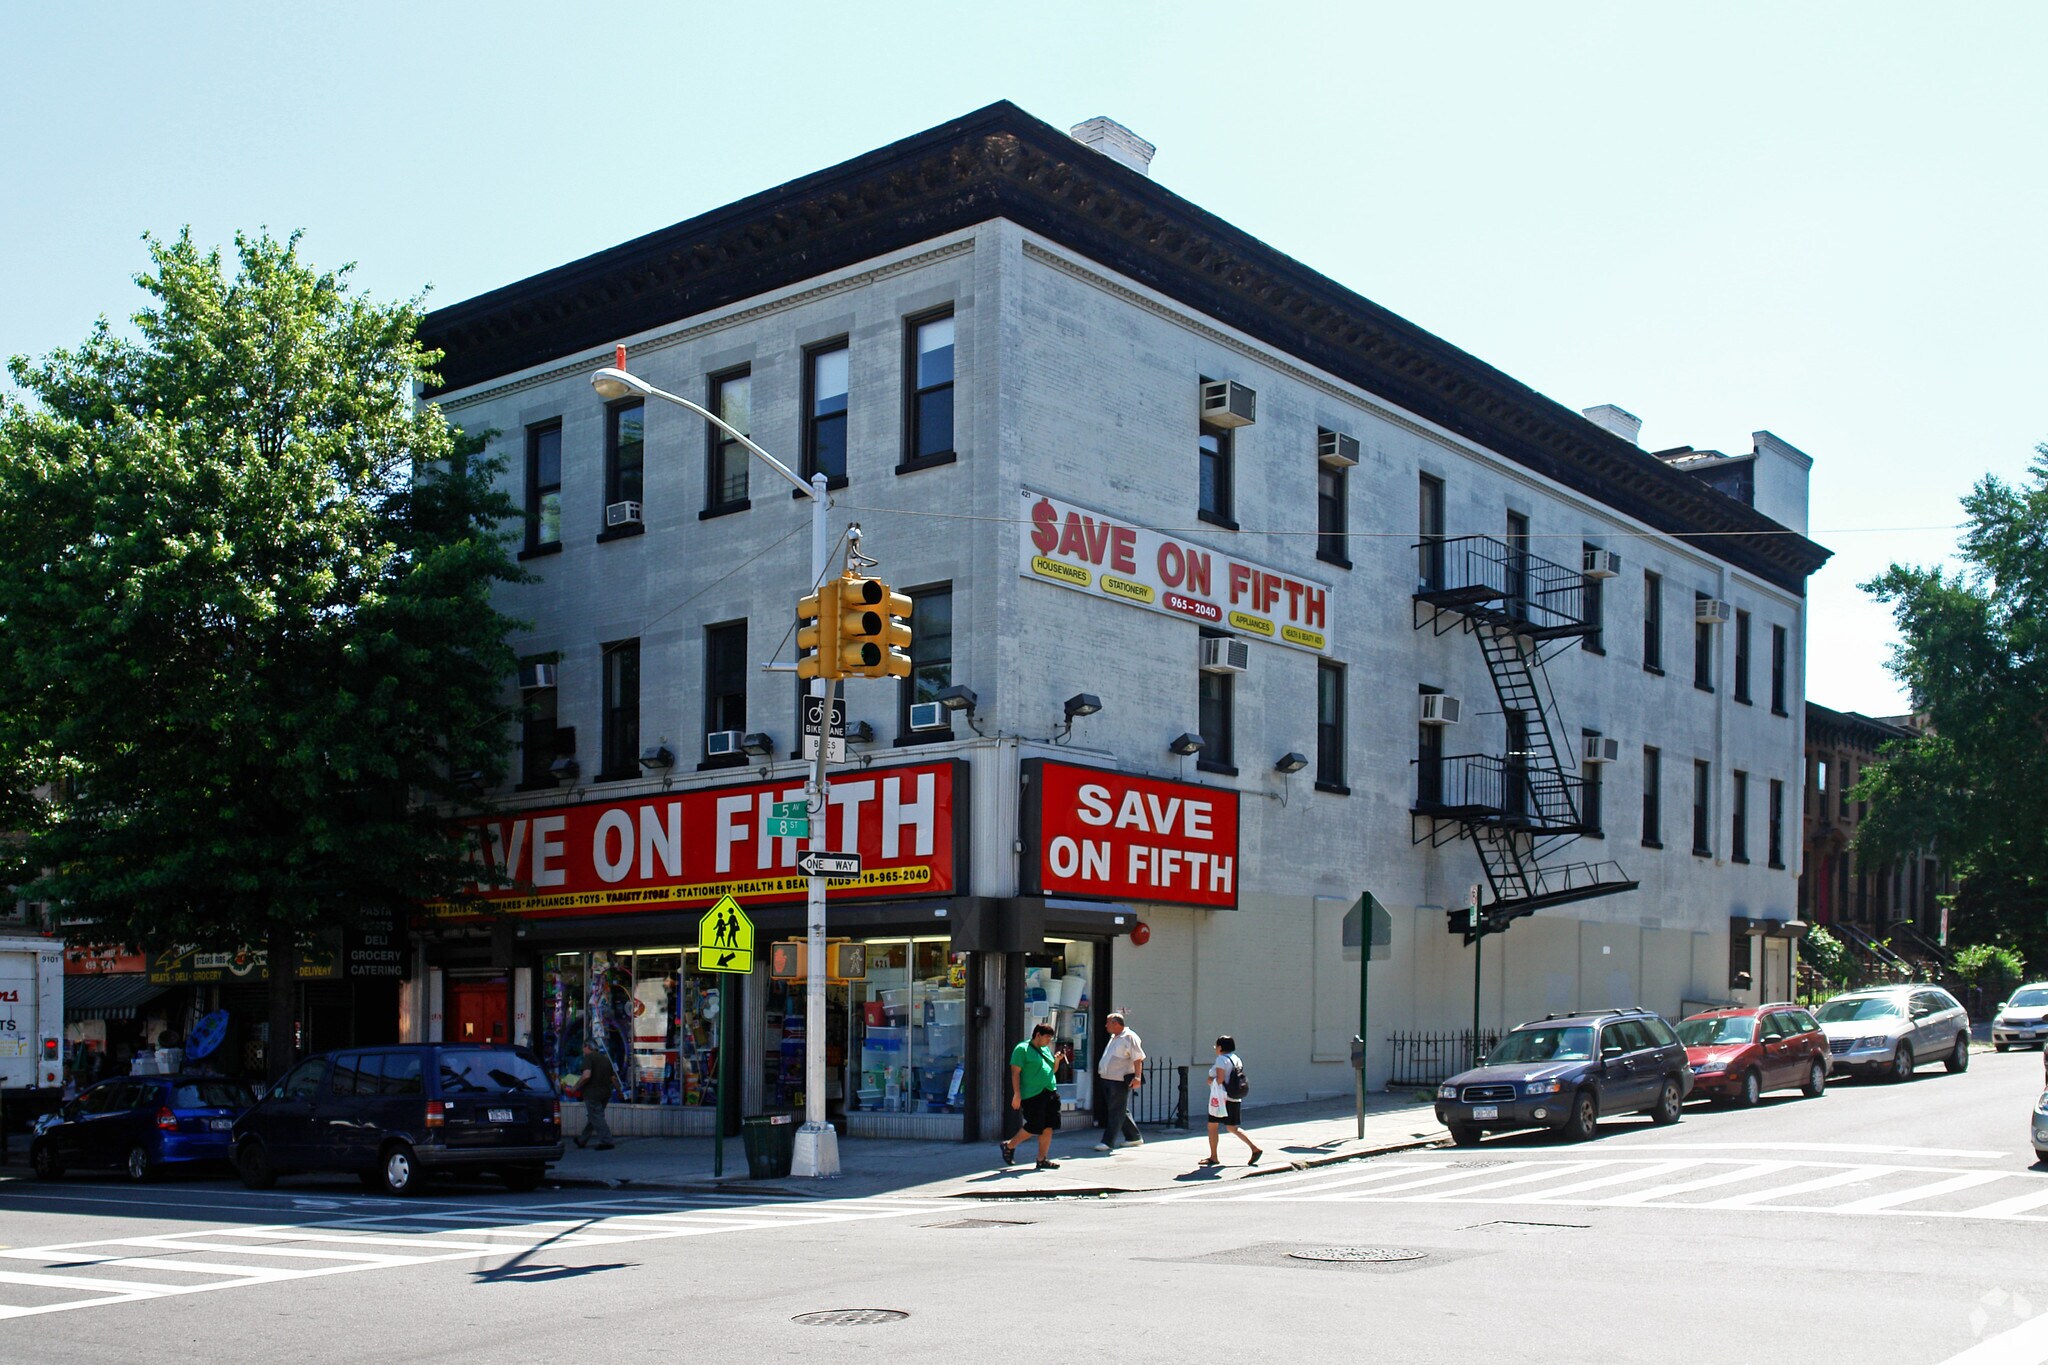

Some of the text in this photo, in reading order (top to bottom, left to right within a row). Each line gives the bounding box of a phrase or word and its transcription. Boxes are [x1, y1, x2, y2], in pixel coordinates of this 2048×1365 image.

[1021, 490, 1031, 499] 421
[1031, 497, 1325, 629] $AVE ON FIFTH
[1037, 559, 1087, 582] HOUSEWARES
[1108, 578, 1149, 597] STATIONERY
[1235, 614, 1271, 632] APPLIANCES
[805, 724, 844, 736] BIKE ANE
[814, 740, 836, 749] BES
[815, 750, 835, 759] OY
[782, 803, 800, 818] 5 AV
[1077, 783, 1214, 840] SAVE
[779, 820, 798, 834] 8 ST
[454, 815, 567, 892] AVE
[593, 802, 682, 883] ON
[806, 858, 854, 871] ONE WAY
[1049, 835, 1233, 894] ON FIFTH
[526, 896, 575, 908] APPLIANCES
[578, 894, 600, 905] TOYS
[606, 890, 641, 902] VARIETY
[643, 889, 670, 900] STORE
[676, 884, 732, 898] STATIONERY
[737, 879, 774, 893] HEALTH
[776, 879, 784, 890] &
[786, 874, 809, 889] BEAU
[365, 935, 388, 945] DELI
[42, 955, 59, 964] 9101
[351, 951, 402, 961] GROCERY
[151, 970, 222, 983] MEATS DELI GROCERY
[298, 966, 332, 977] DELIVERY
[351, 965, 402, 976] CATERING
